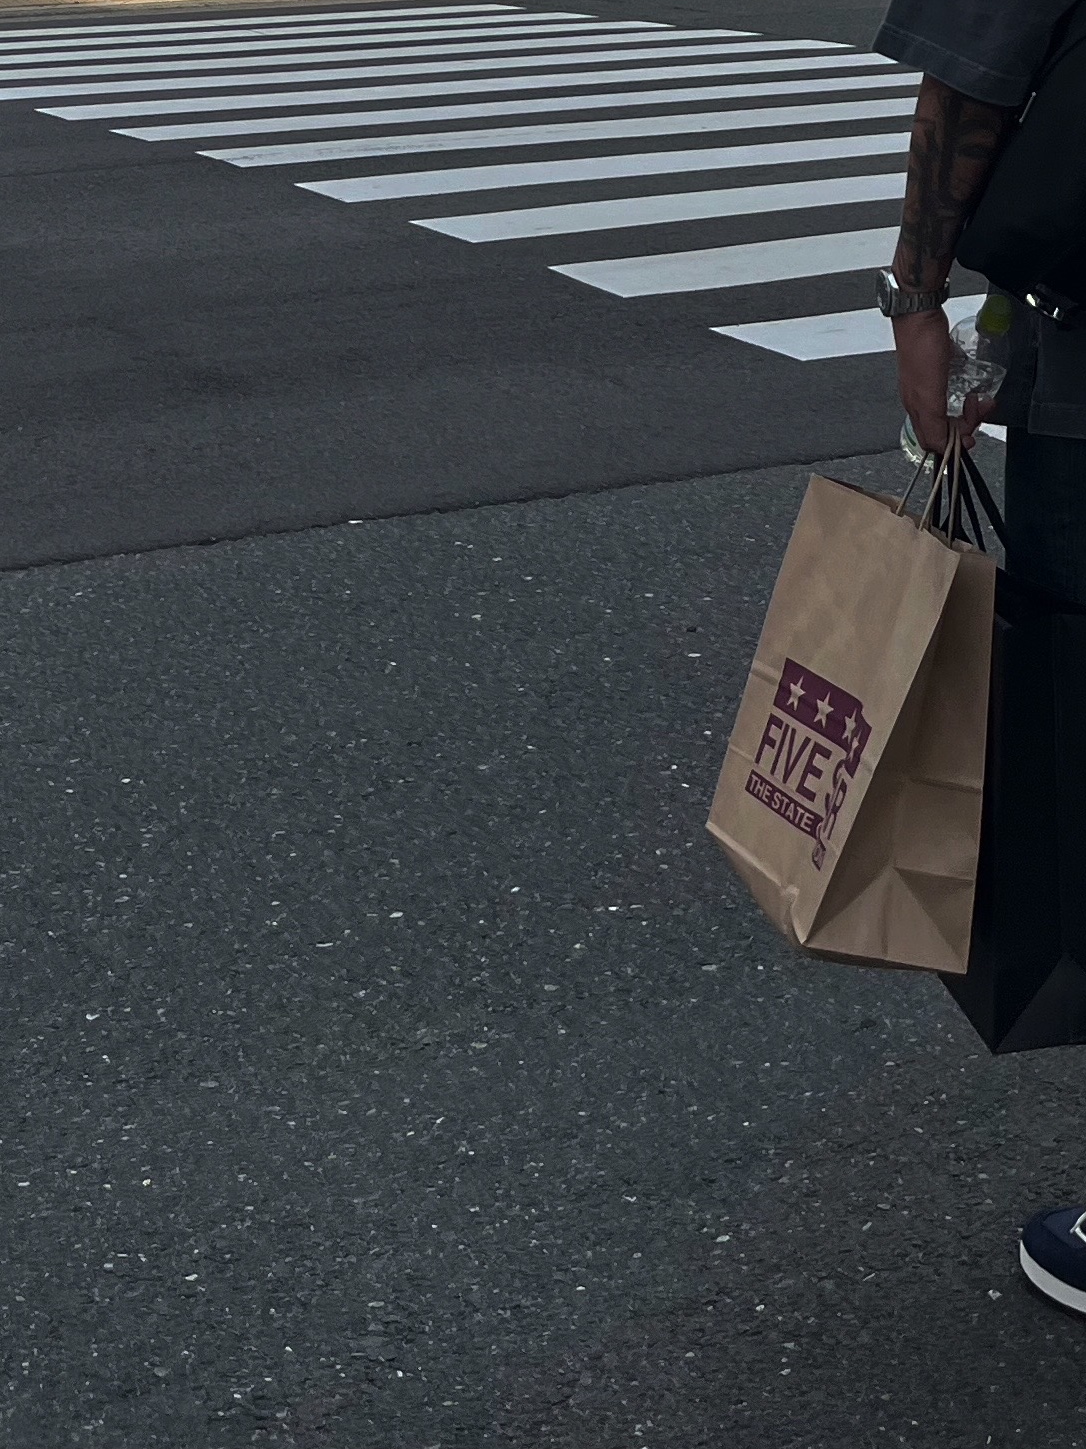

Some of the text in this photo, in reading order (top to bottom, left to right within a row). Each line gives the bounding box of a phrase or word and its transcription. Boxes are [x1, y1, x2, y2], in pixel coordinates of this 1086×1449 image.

[754, 712, 833, 803] FIVE
[749, 773, 815, 832] THE STATE
